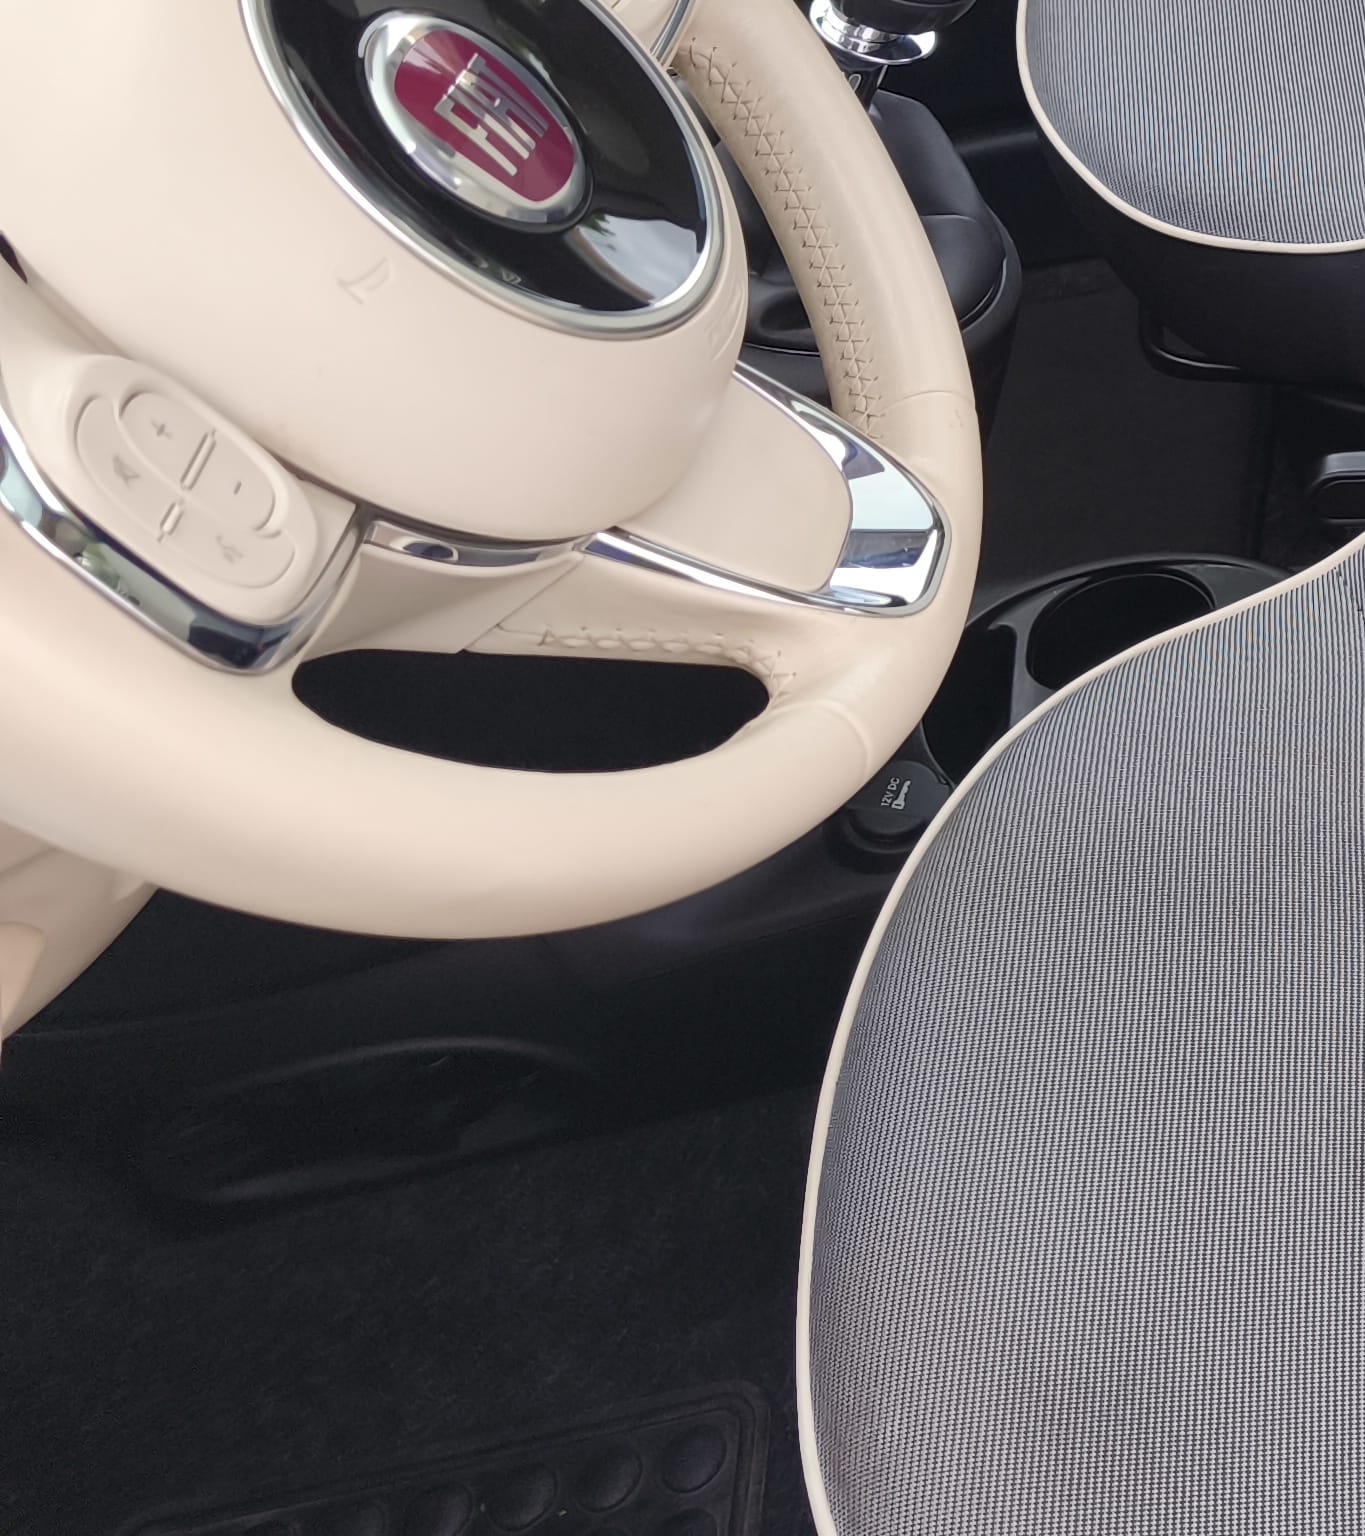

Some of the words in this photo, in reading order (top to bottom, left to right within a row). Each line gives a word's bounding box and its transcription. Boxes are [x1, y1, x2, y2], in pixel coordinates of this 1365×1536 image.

[433, 52, 550, 177] FIAT
[887, 777, 900, 791] DC
[880, 790, 895, 807] 12V
